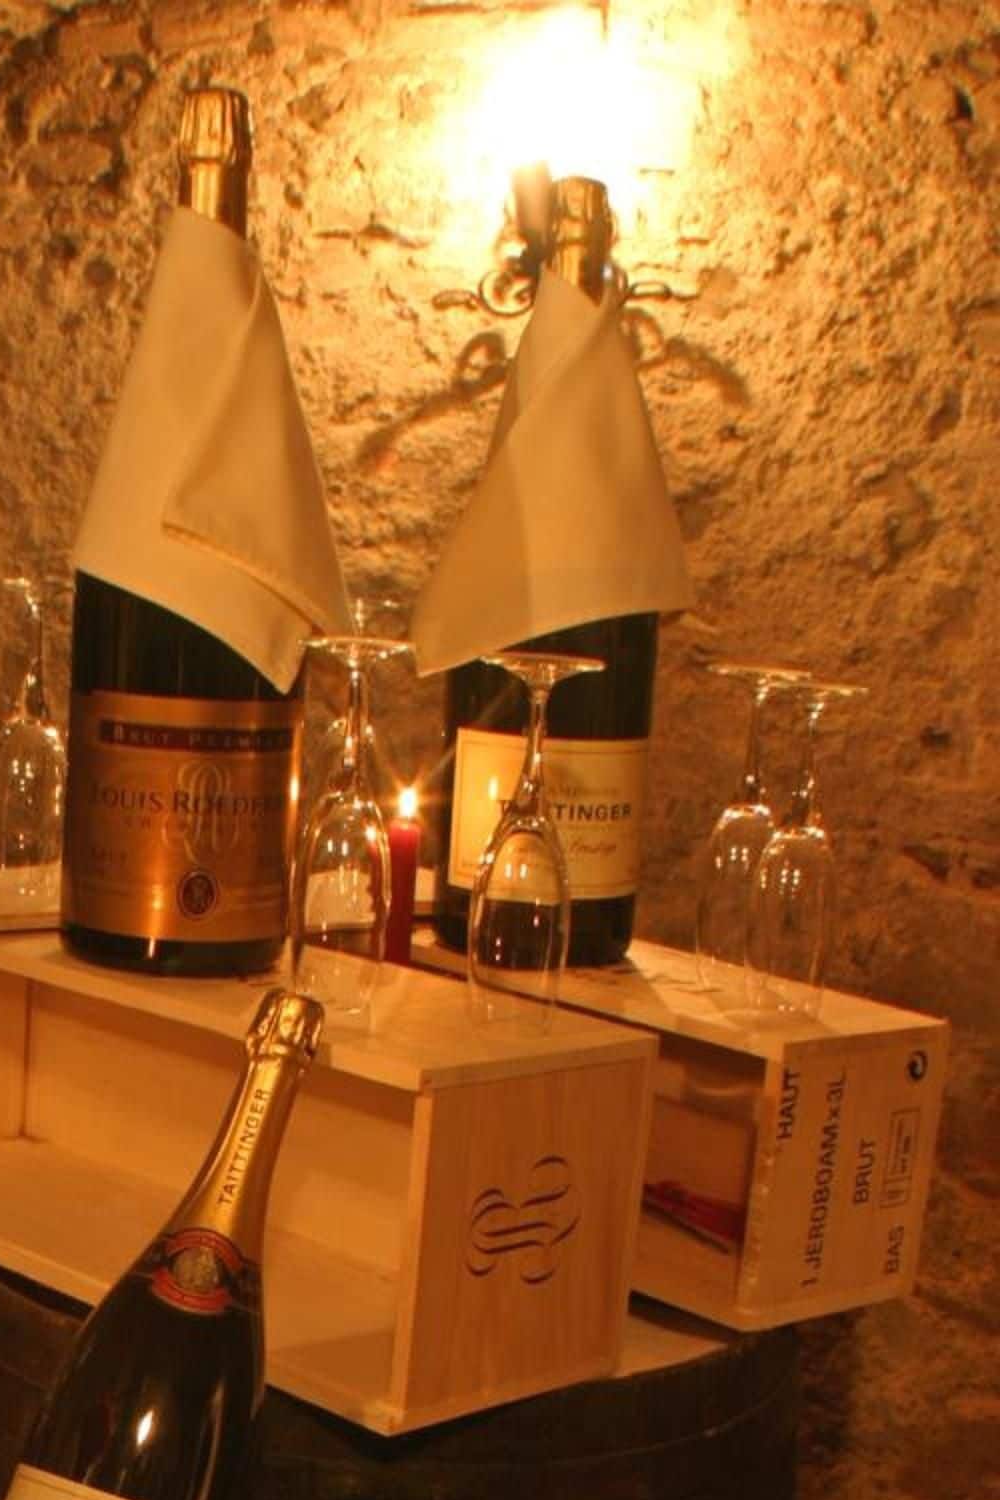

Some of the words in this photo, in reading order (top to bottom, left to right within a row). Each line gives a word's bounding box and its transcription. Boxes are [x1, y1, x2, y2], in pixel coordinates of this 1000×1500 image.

[776, 1069, 801, 1141] HAUT
[216, 1088, 271, 1205] TAITTINGER
[853, 1138, 876, 1205] BRUT
[803, 1120, 841, 1272] JEROBOAM
[884, 1224, 905, 1274] BAS
